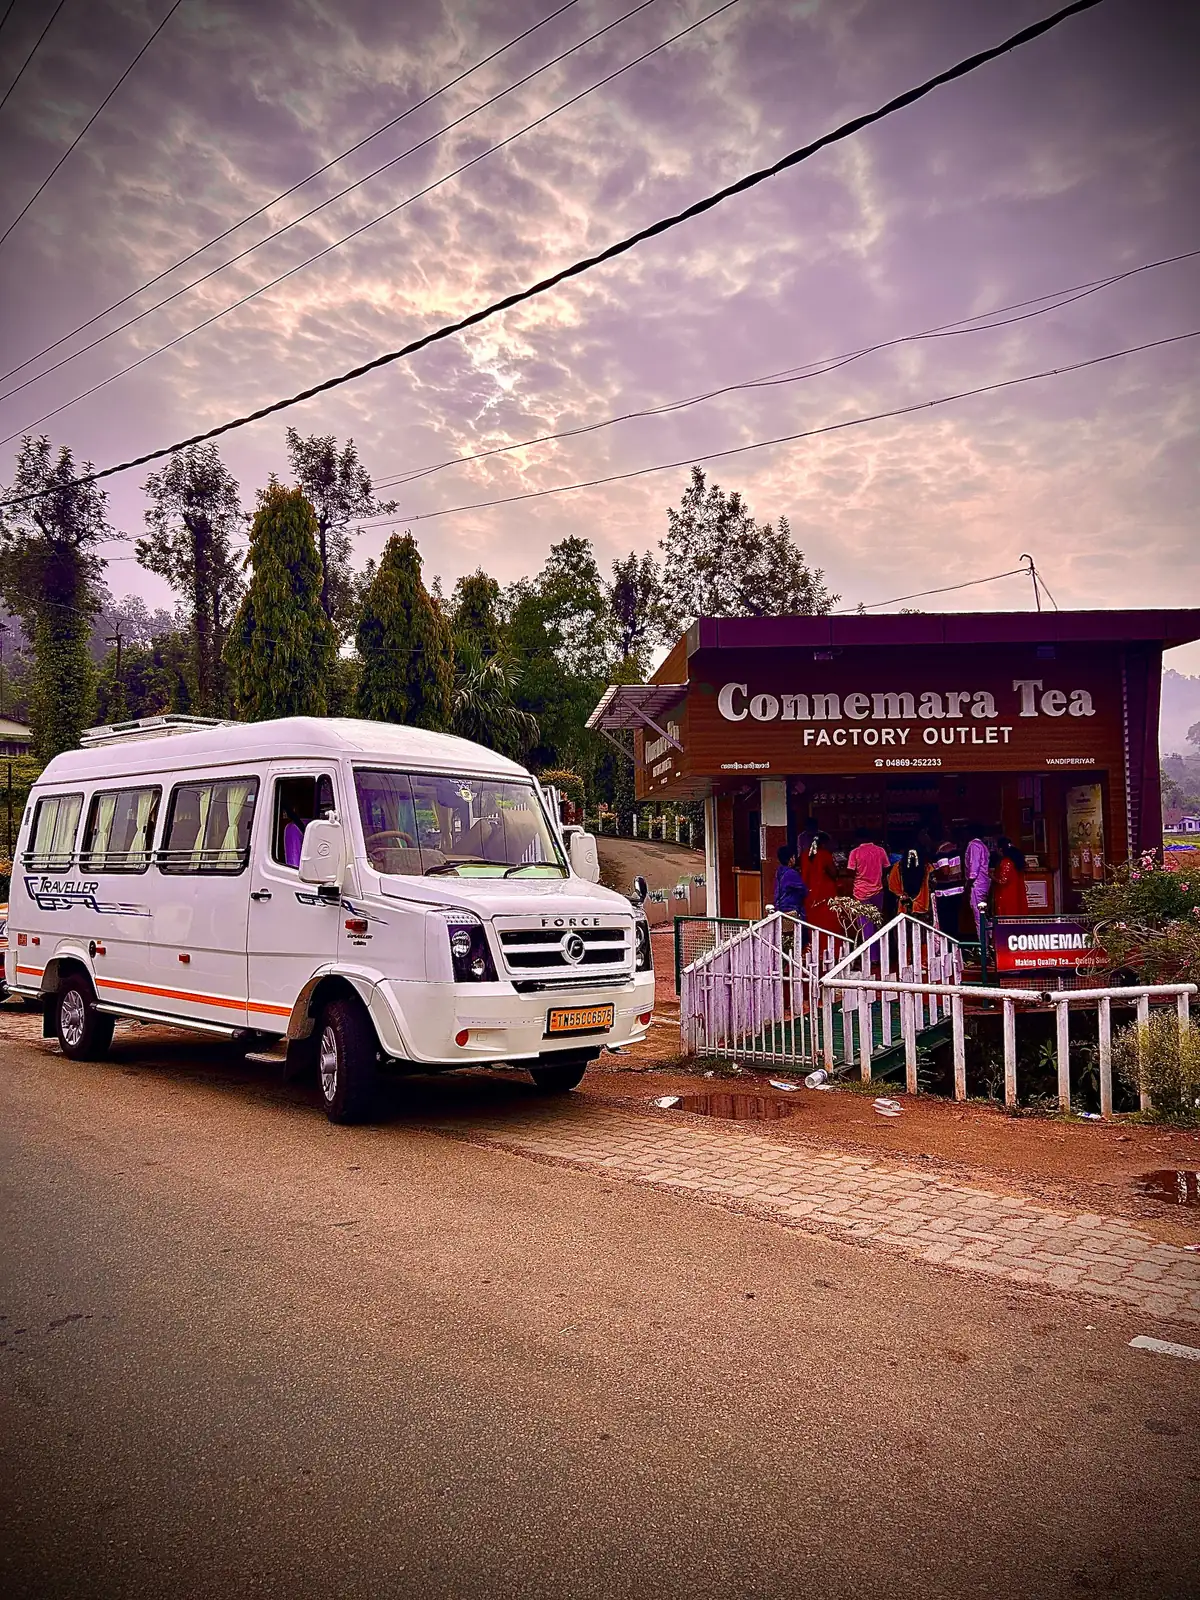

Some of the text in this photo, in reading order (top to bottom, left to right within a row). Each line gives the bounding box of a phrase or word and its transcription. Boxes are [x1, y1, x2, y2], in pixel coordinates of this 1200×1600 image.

[717, 679, 1096, 722] Connemara Tea
[803, 726, 1013, 746] FACTORY OUTLET
[885, 758, 942, 767] 04869-252233
[1045, 757, 1096, 765] VANDIPERIYAR
[541, 918, 601, 928] FORCE
[1007, 933, 1097, 951] CONNEMAR
[1015, 958, 1037, 967] Making
[1037, 957, 1058, 967] Quality
